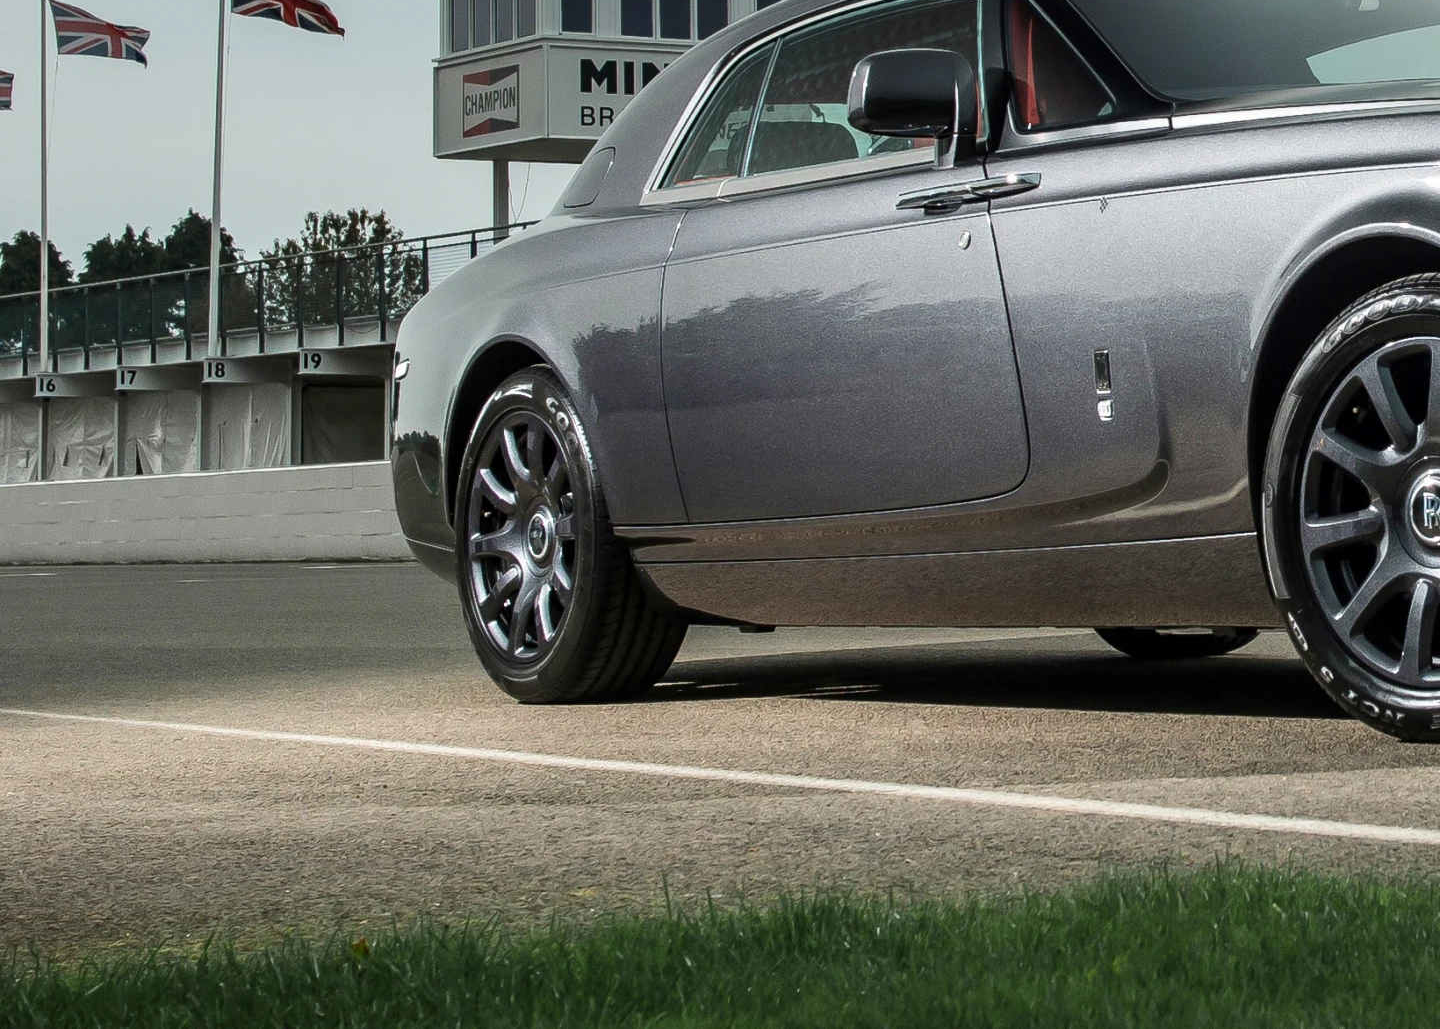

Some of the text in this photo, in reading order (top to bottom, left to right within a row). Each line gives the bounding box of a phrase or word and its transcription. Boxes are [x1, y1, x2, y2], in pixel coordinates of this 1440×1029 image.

[465, 86, 516, 117] CHAMPION
[303, 352, 322, 370] 19
[119, 370, 137, 386] 17
[206, 362, 226, 379] 18
[38, 377, 56, 393] 16
